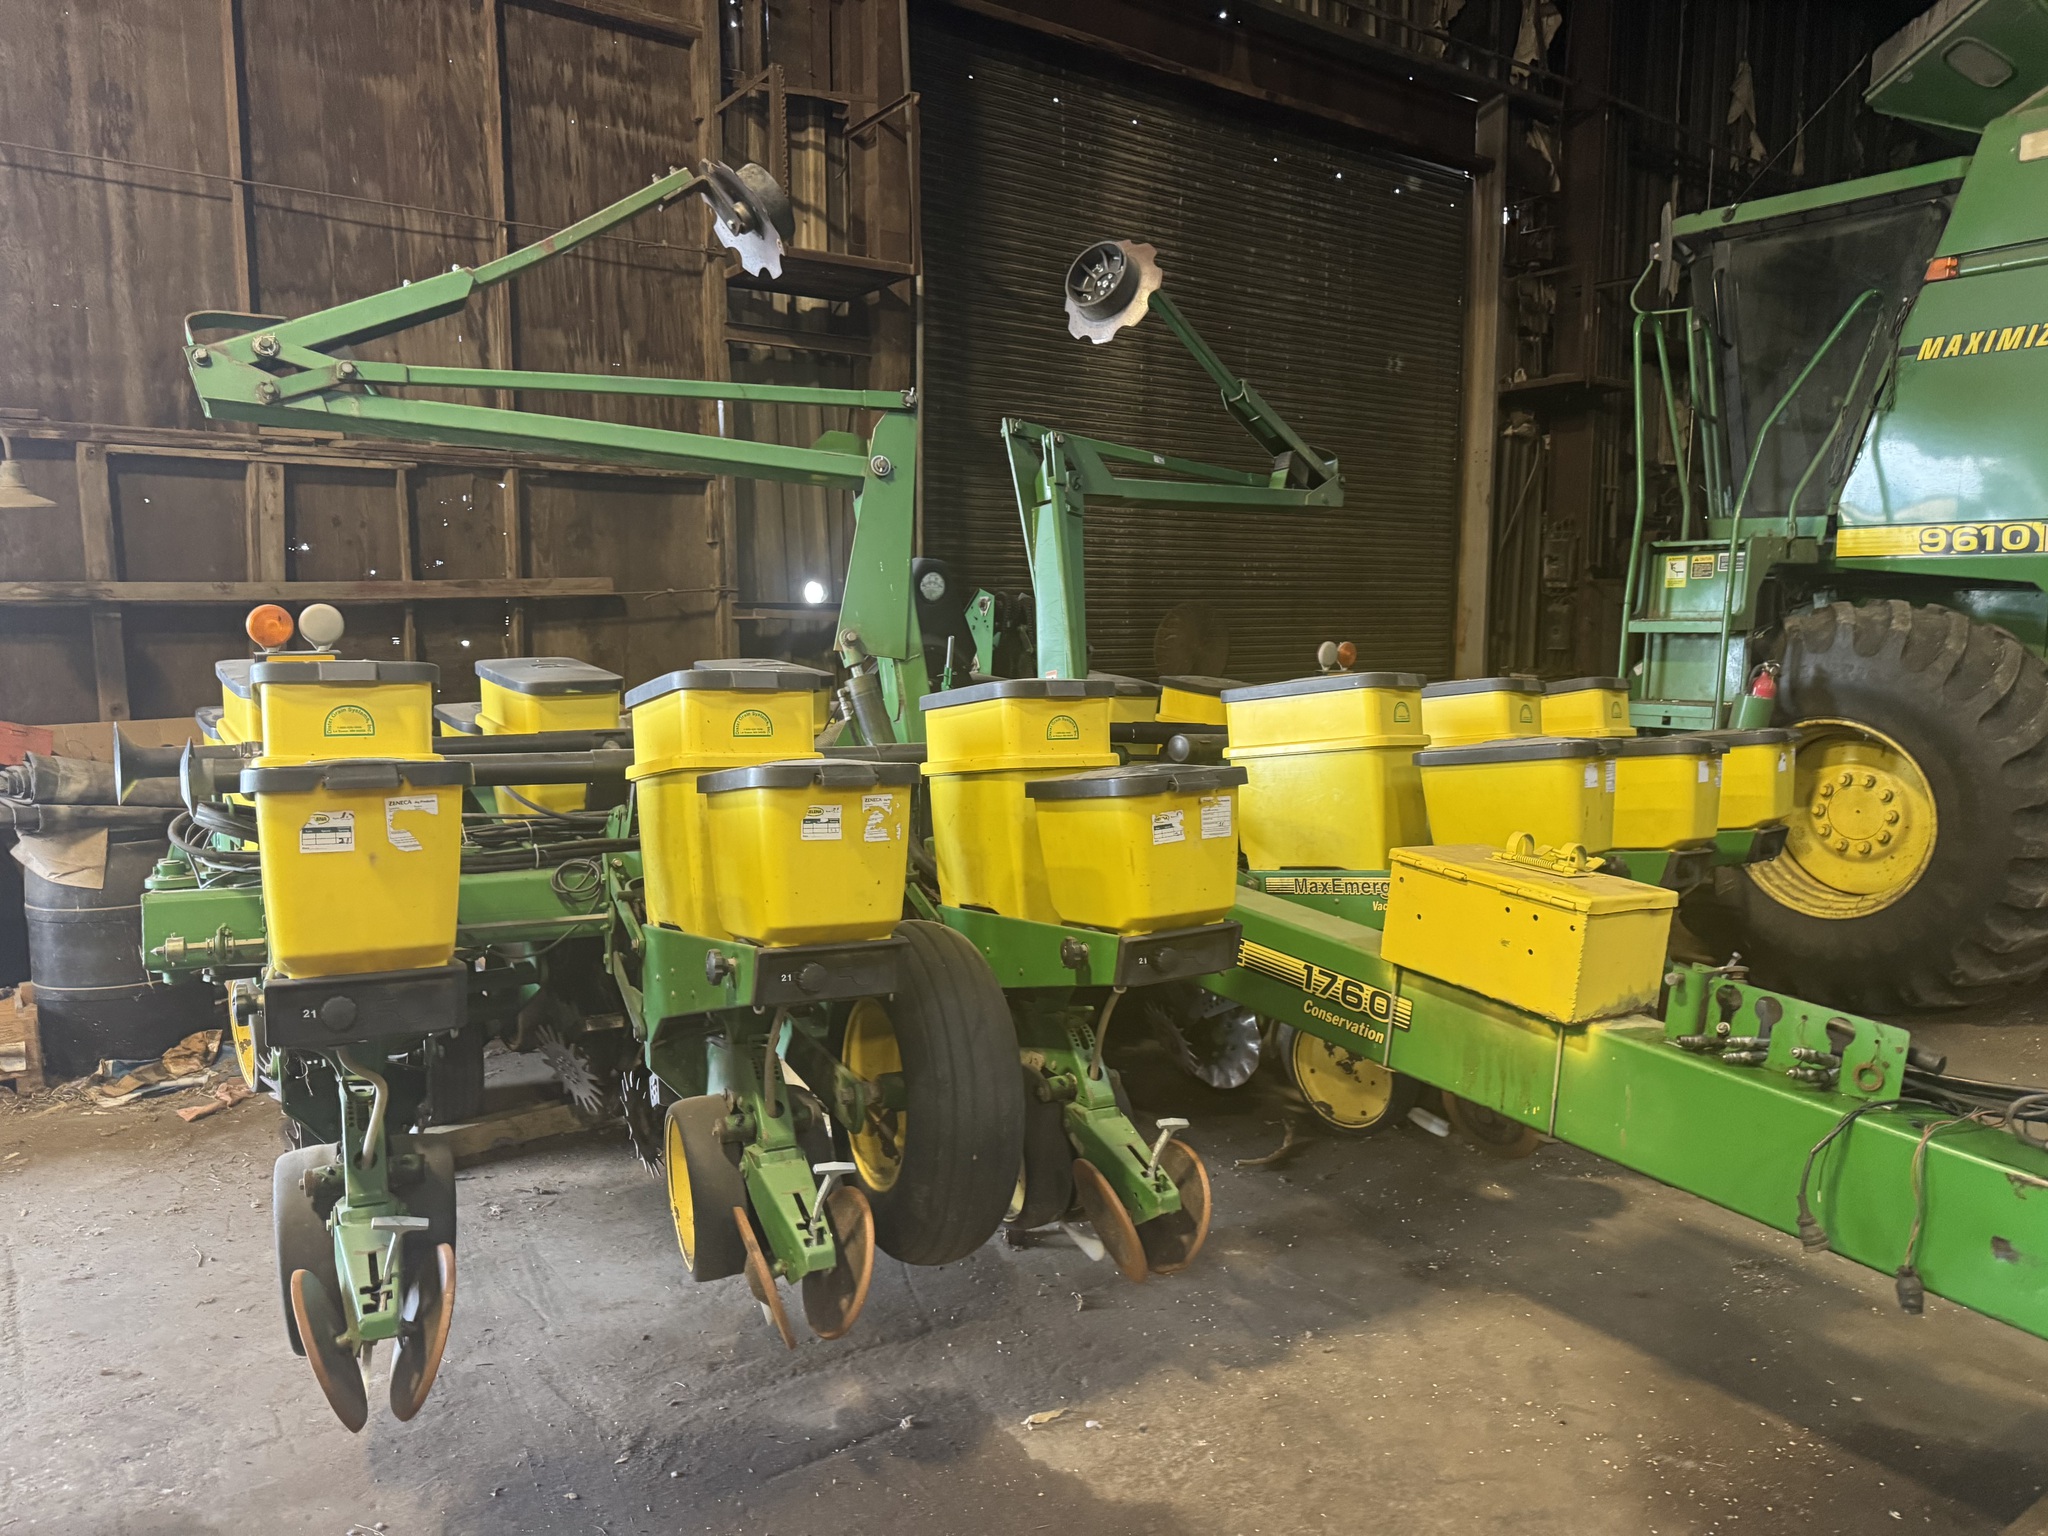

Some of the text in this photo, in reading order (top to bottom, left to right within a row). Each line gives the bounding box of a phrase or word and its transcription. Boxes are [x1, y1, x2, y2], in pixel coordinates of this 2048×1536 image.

[1919, 524, 2033, 554] 9610
[1294, 878, 1390, 899] MaxEmerg
[781, 974, 792, 982] 21
[1302, 964, 1393, 1023] 1760
[303, 1009, 316, 1018] 21
[1303, 999, 1385, 1044] Conservation
